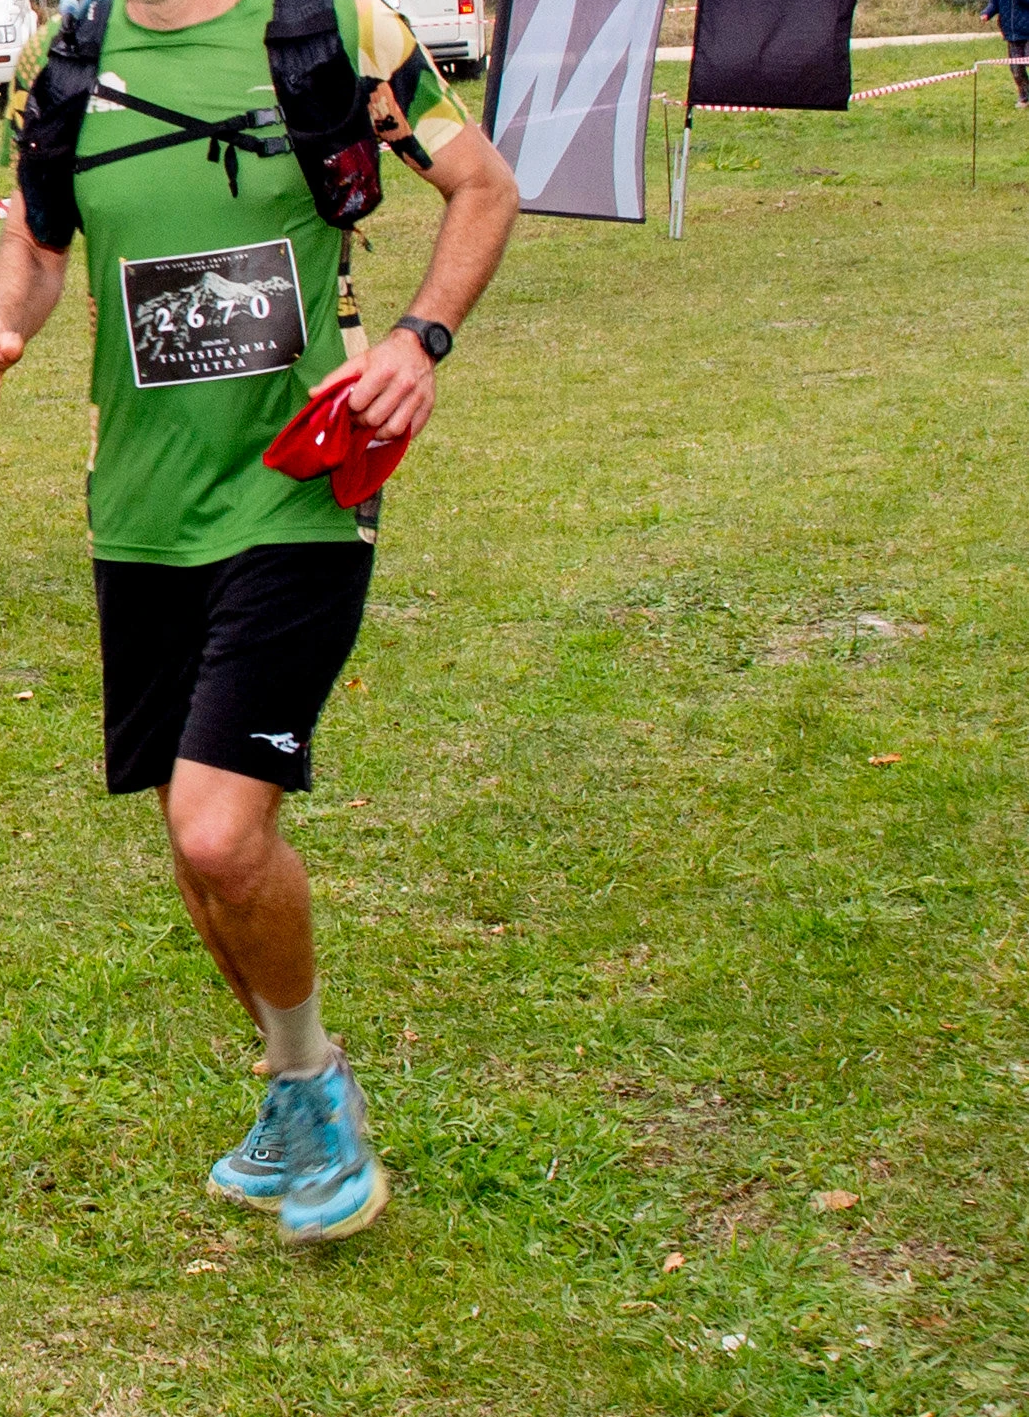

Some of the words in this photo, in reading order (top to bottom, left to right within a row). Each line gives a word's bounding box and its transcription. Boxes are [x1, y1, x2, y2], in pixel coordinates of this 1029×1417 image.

[155, 295, 270, 332] 2670
[159, 339, 277, 364] TSITSIKAMMA
[190, 358, 246, 374] ULTRA
